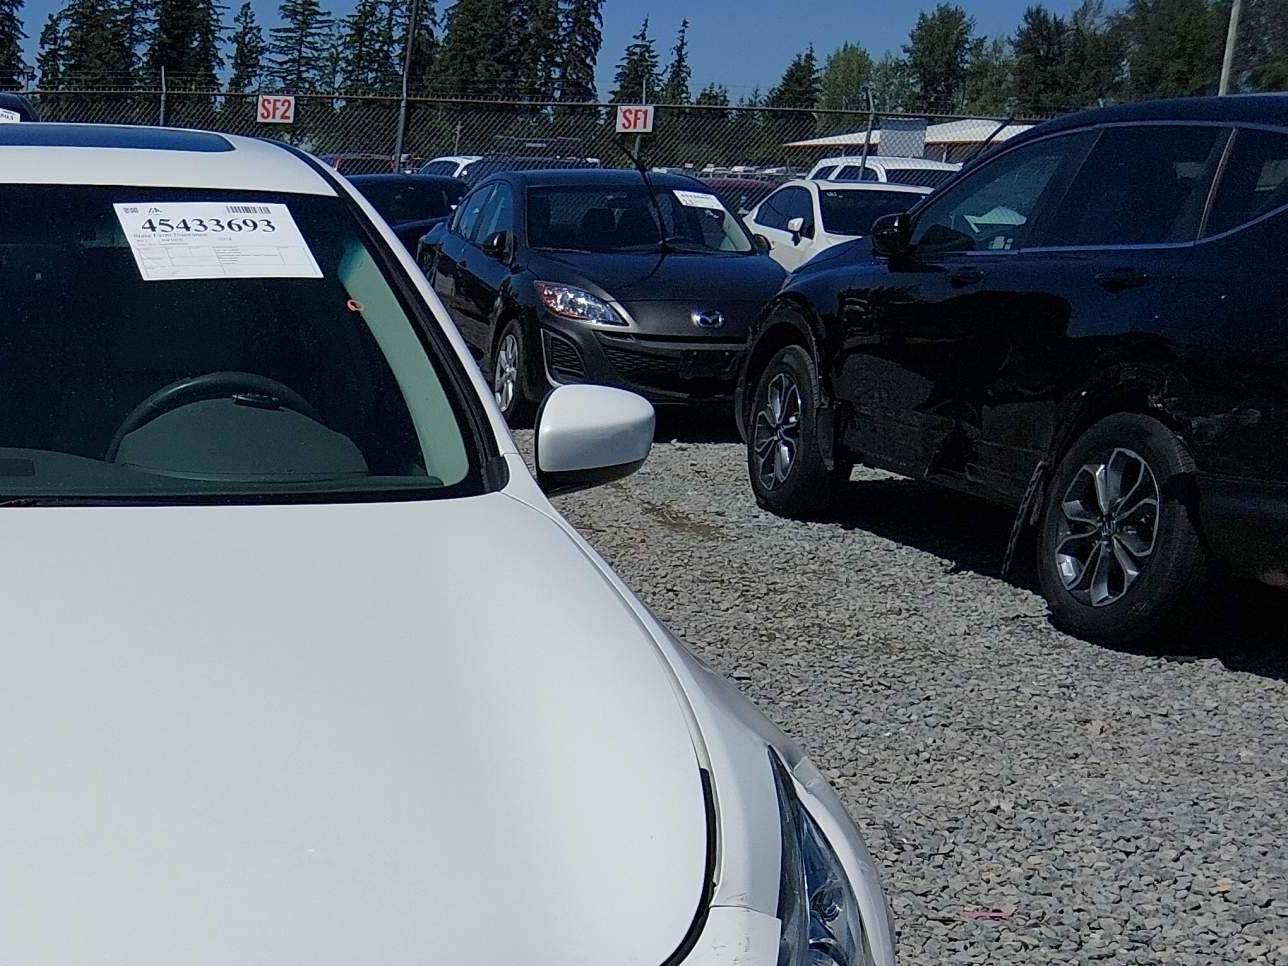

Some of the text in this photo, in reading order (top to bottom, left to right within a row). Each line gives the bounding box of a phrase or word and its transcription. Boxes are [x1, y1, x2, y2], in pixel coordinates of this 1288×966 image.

[260, 98, 291, 120] SF2
[622, 108, 649, 130] SF1
[141, 218, 276, 233] 45433693
